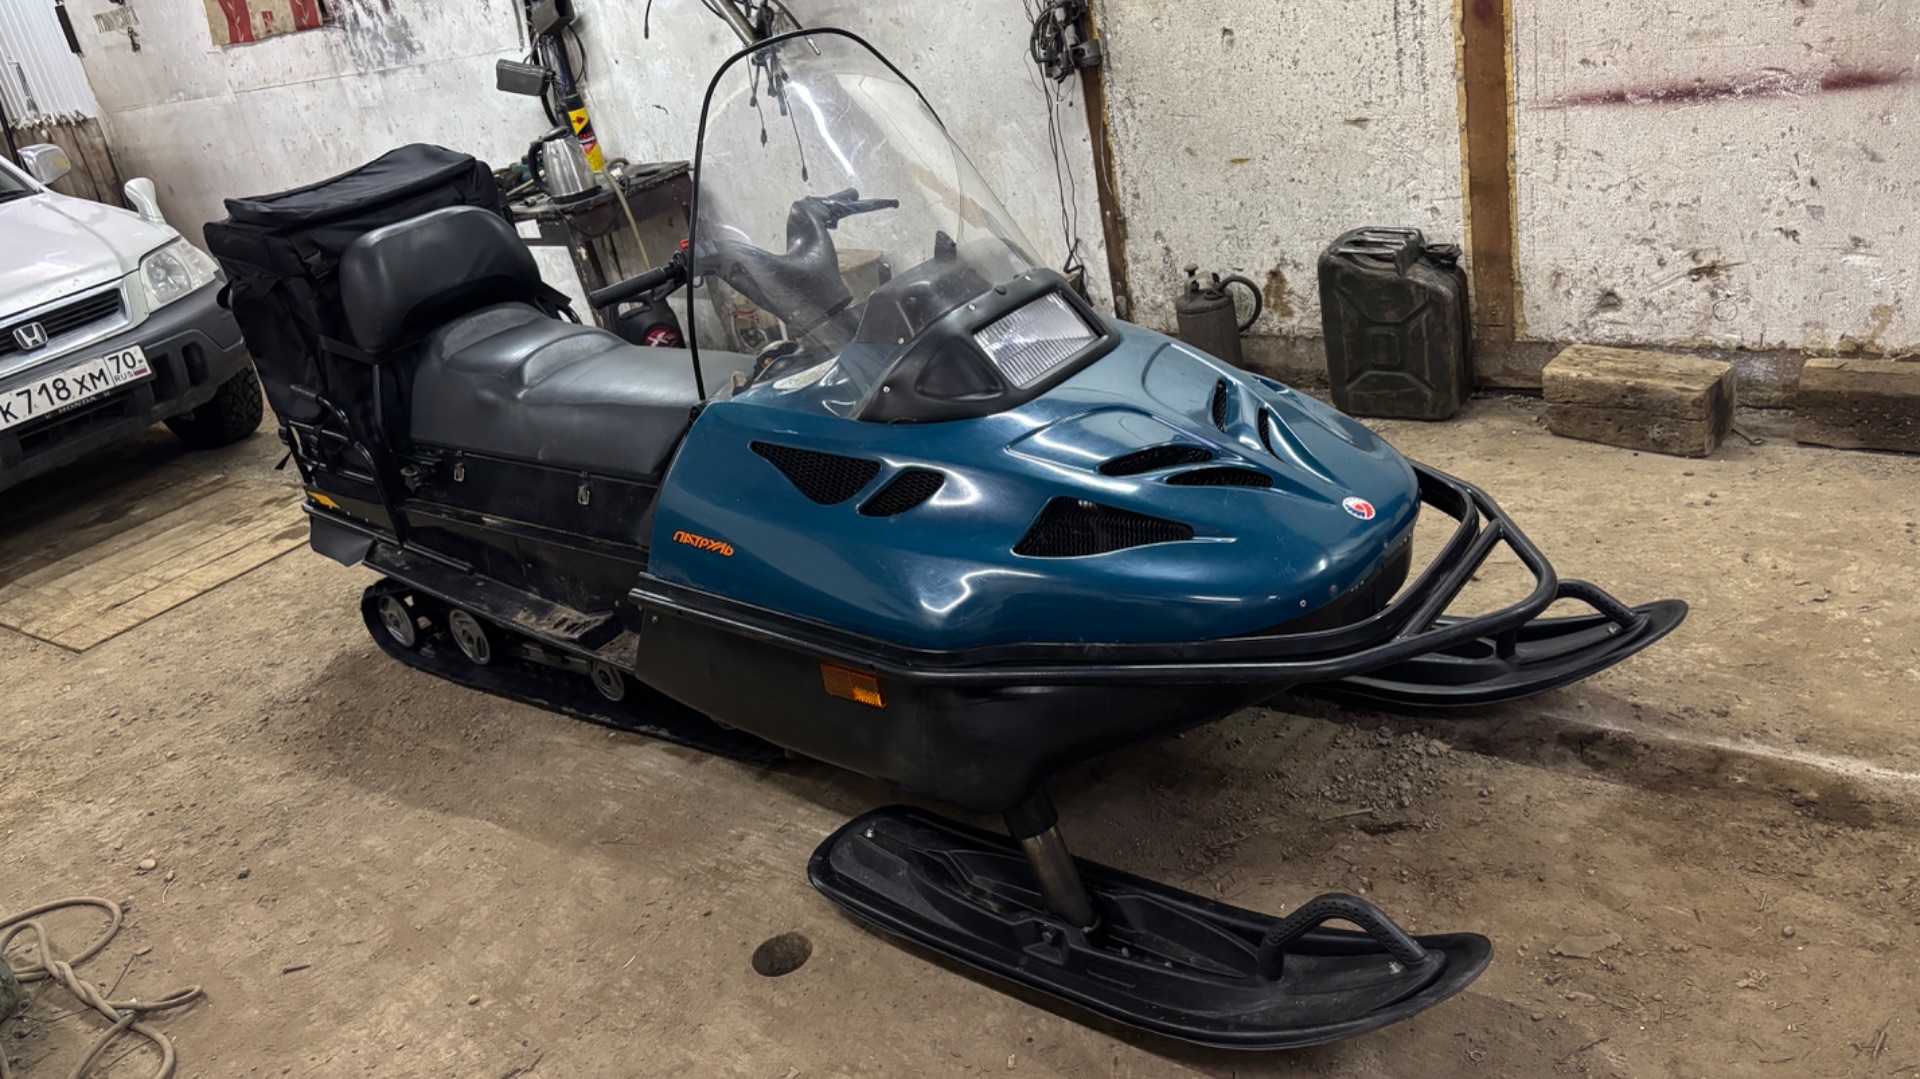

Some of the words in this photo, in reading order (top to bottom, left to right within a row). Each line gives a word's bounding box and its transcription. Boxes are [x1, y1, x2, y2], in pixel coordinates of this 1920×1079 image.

[108, 351, 136, 374] 70
[114, 370, 134, 382] RUS
[59, 396, 97, 413] HONDA
[673, 530, 734, 556] ПАТРУЛЬ
